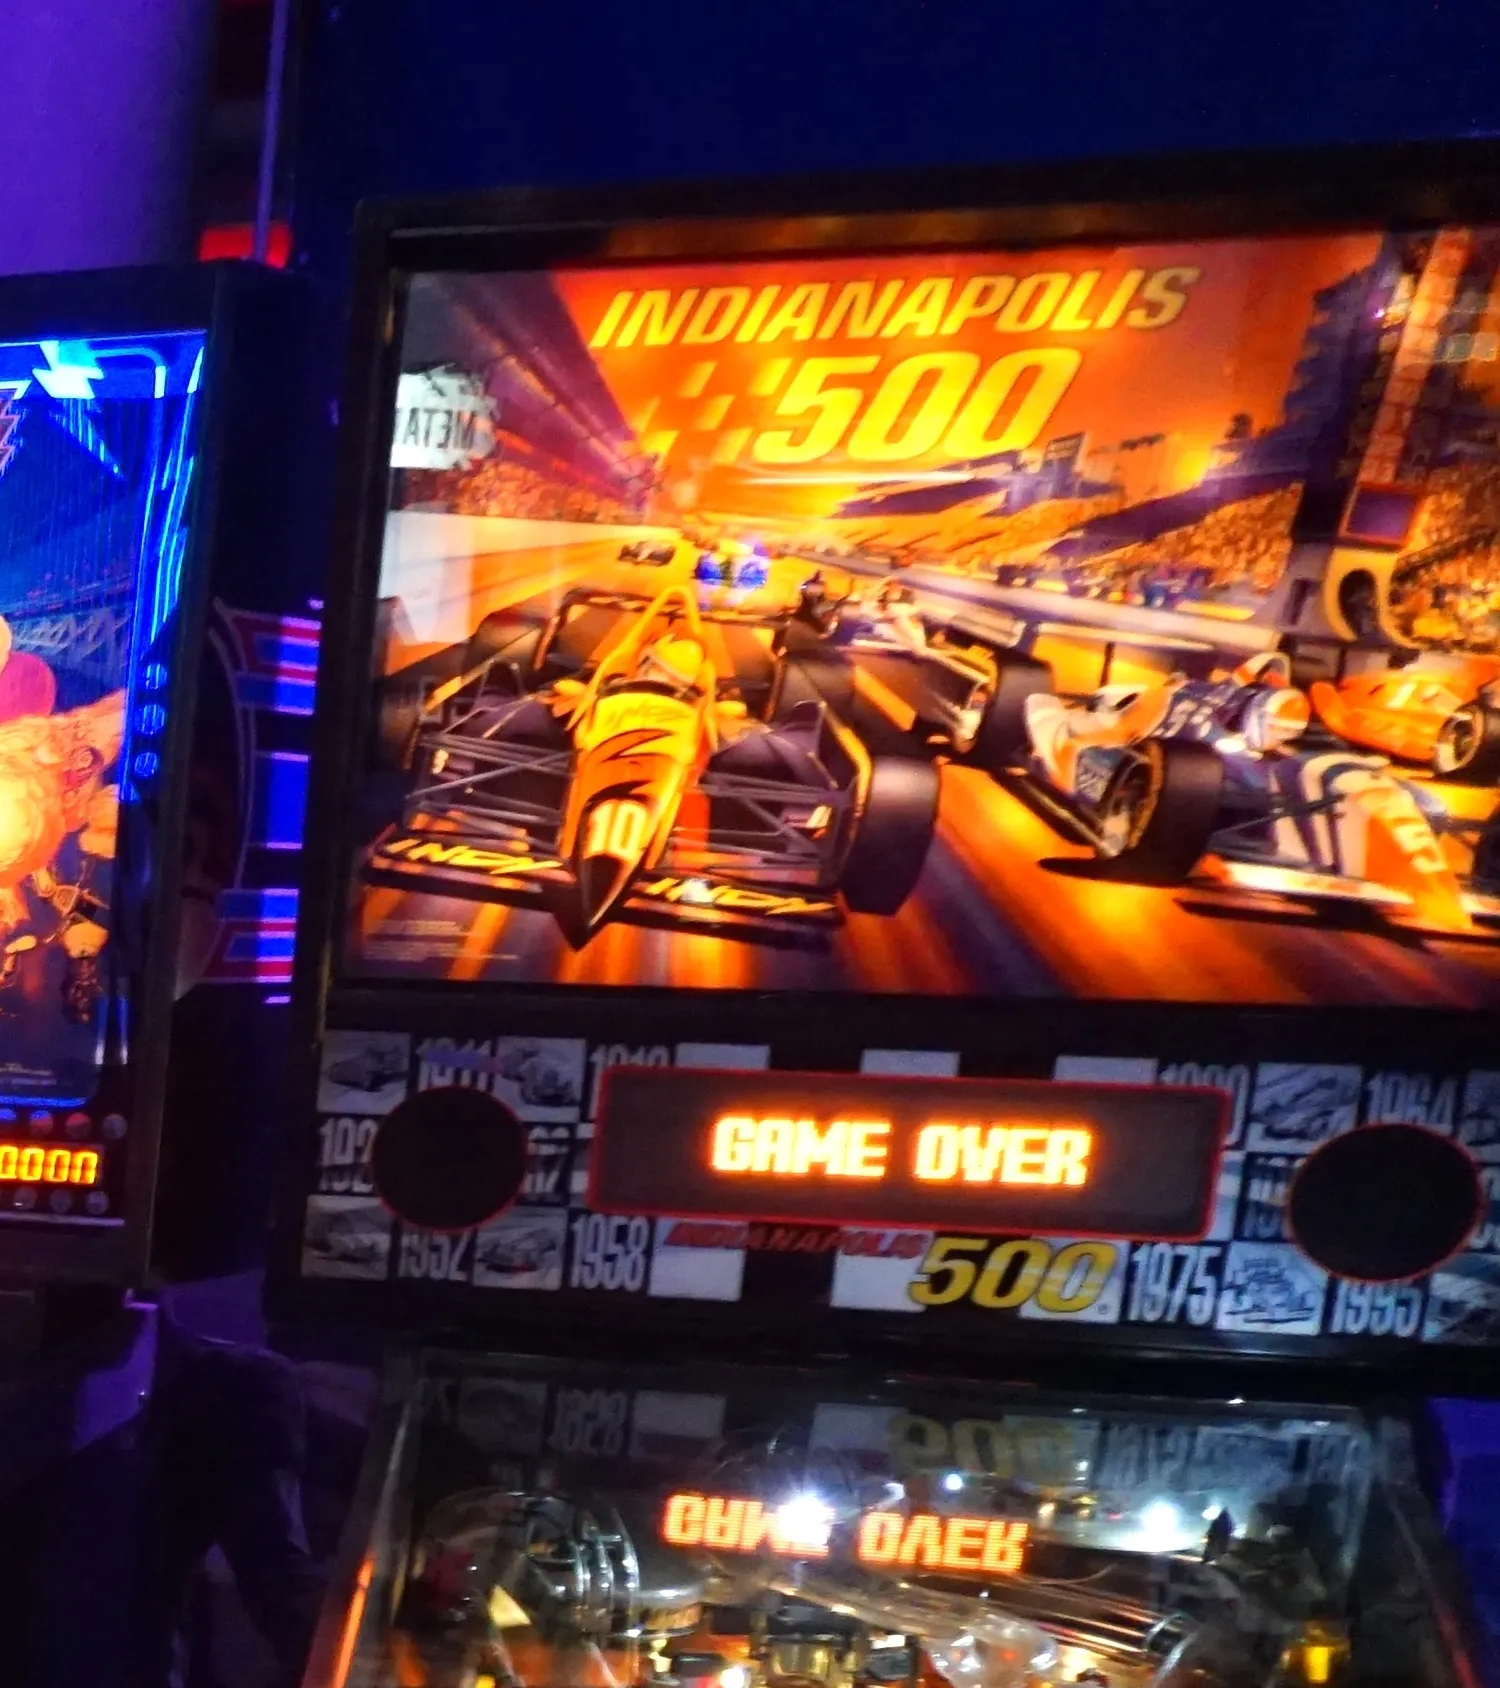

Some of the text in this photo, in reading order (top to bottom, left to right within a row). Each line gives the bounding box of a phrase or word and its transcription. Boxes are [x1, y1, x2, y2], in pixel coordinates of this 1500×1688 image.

[591, 267, 1200, 347] INDIANAPOLIS
[752, 347, 1082, 464] 500
[588, 800, 650, 857] 10
[386, 838, 836, 916] INDY INDY
[712, 1115, 1091, 1187] GAME OVER
[569, 1212, 650, 1292] 1958
[908, 1237, 1118, 1313] 500
[1127, 1242, 1223, 1326] 1975
